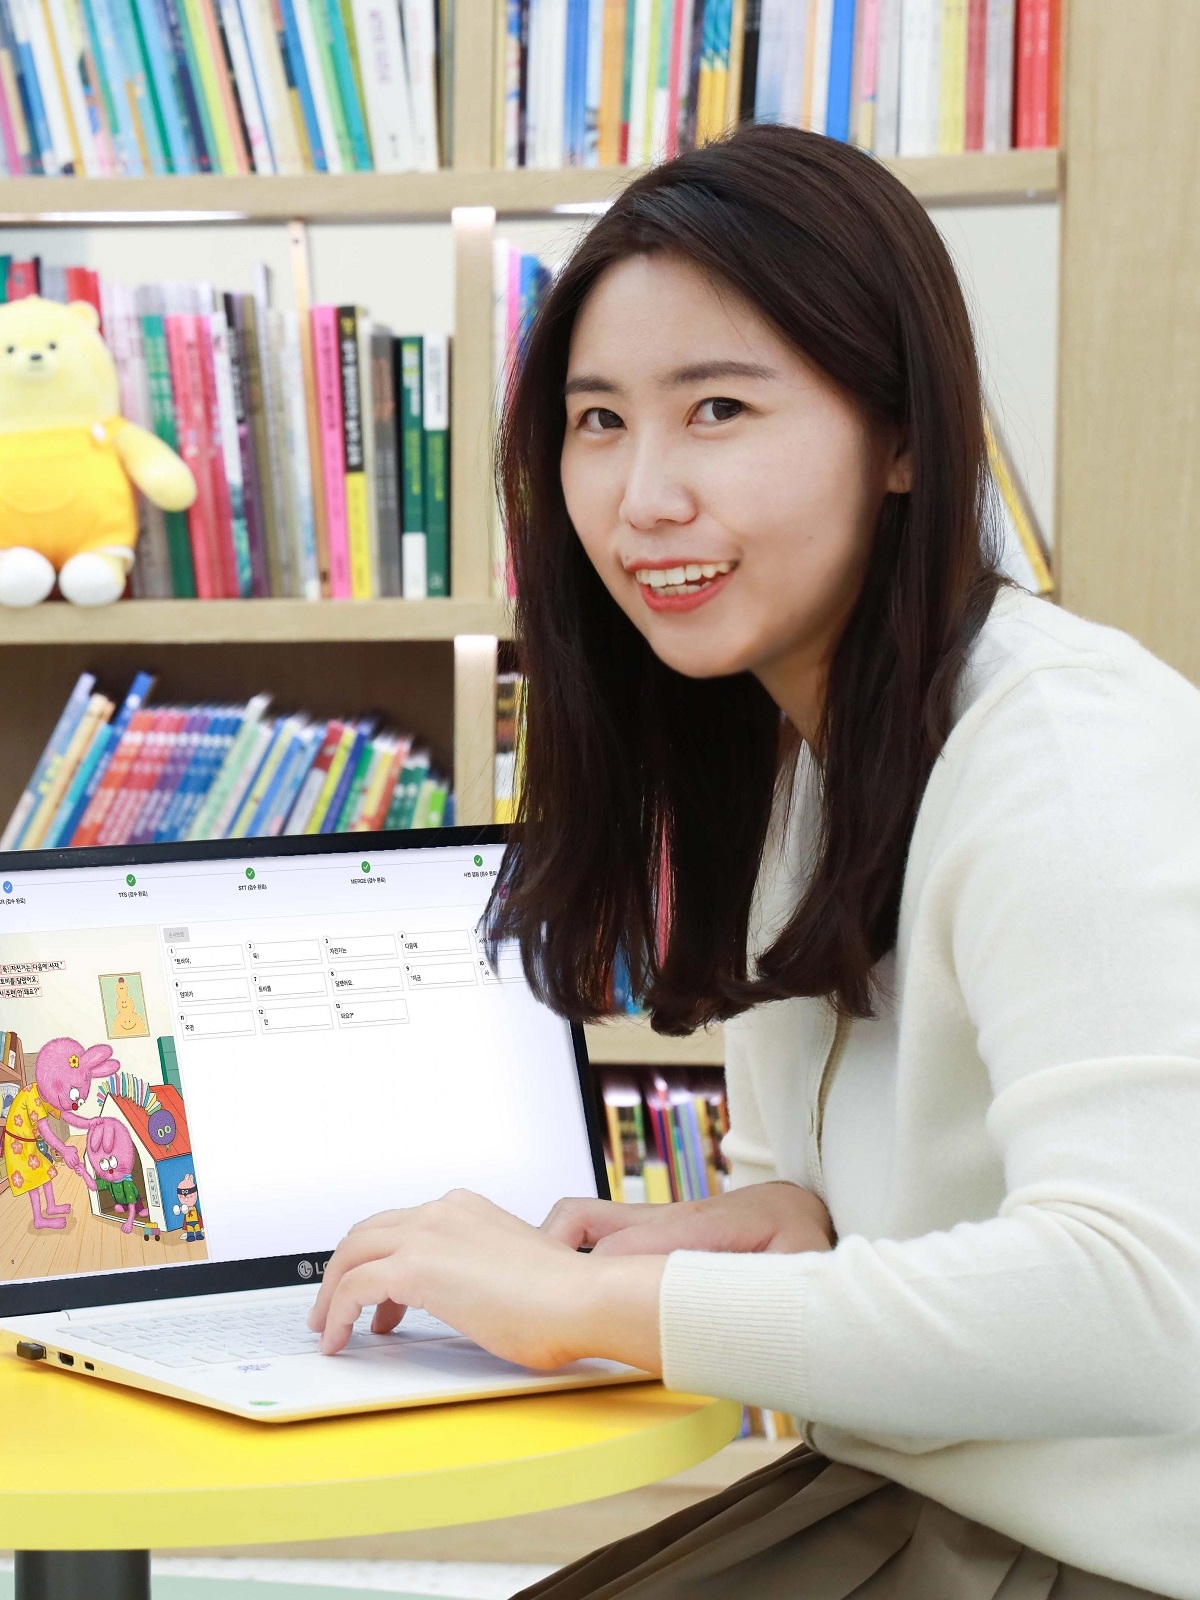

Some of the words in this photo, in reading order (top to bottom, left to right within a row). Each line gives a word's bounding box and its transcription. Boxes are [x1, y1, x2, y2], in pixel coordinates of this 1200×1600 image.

[10, 964, 31, 972] 자전거는
[33, 962, 48, 972] 다음에
[0, 977, 15, 985] 토비를
[16, 976, 39, 985] 달랬어요.
[17, 989, 22, 997] 안
[179, 990, 194, 998] 엄마가
